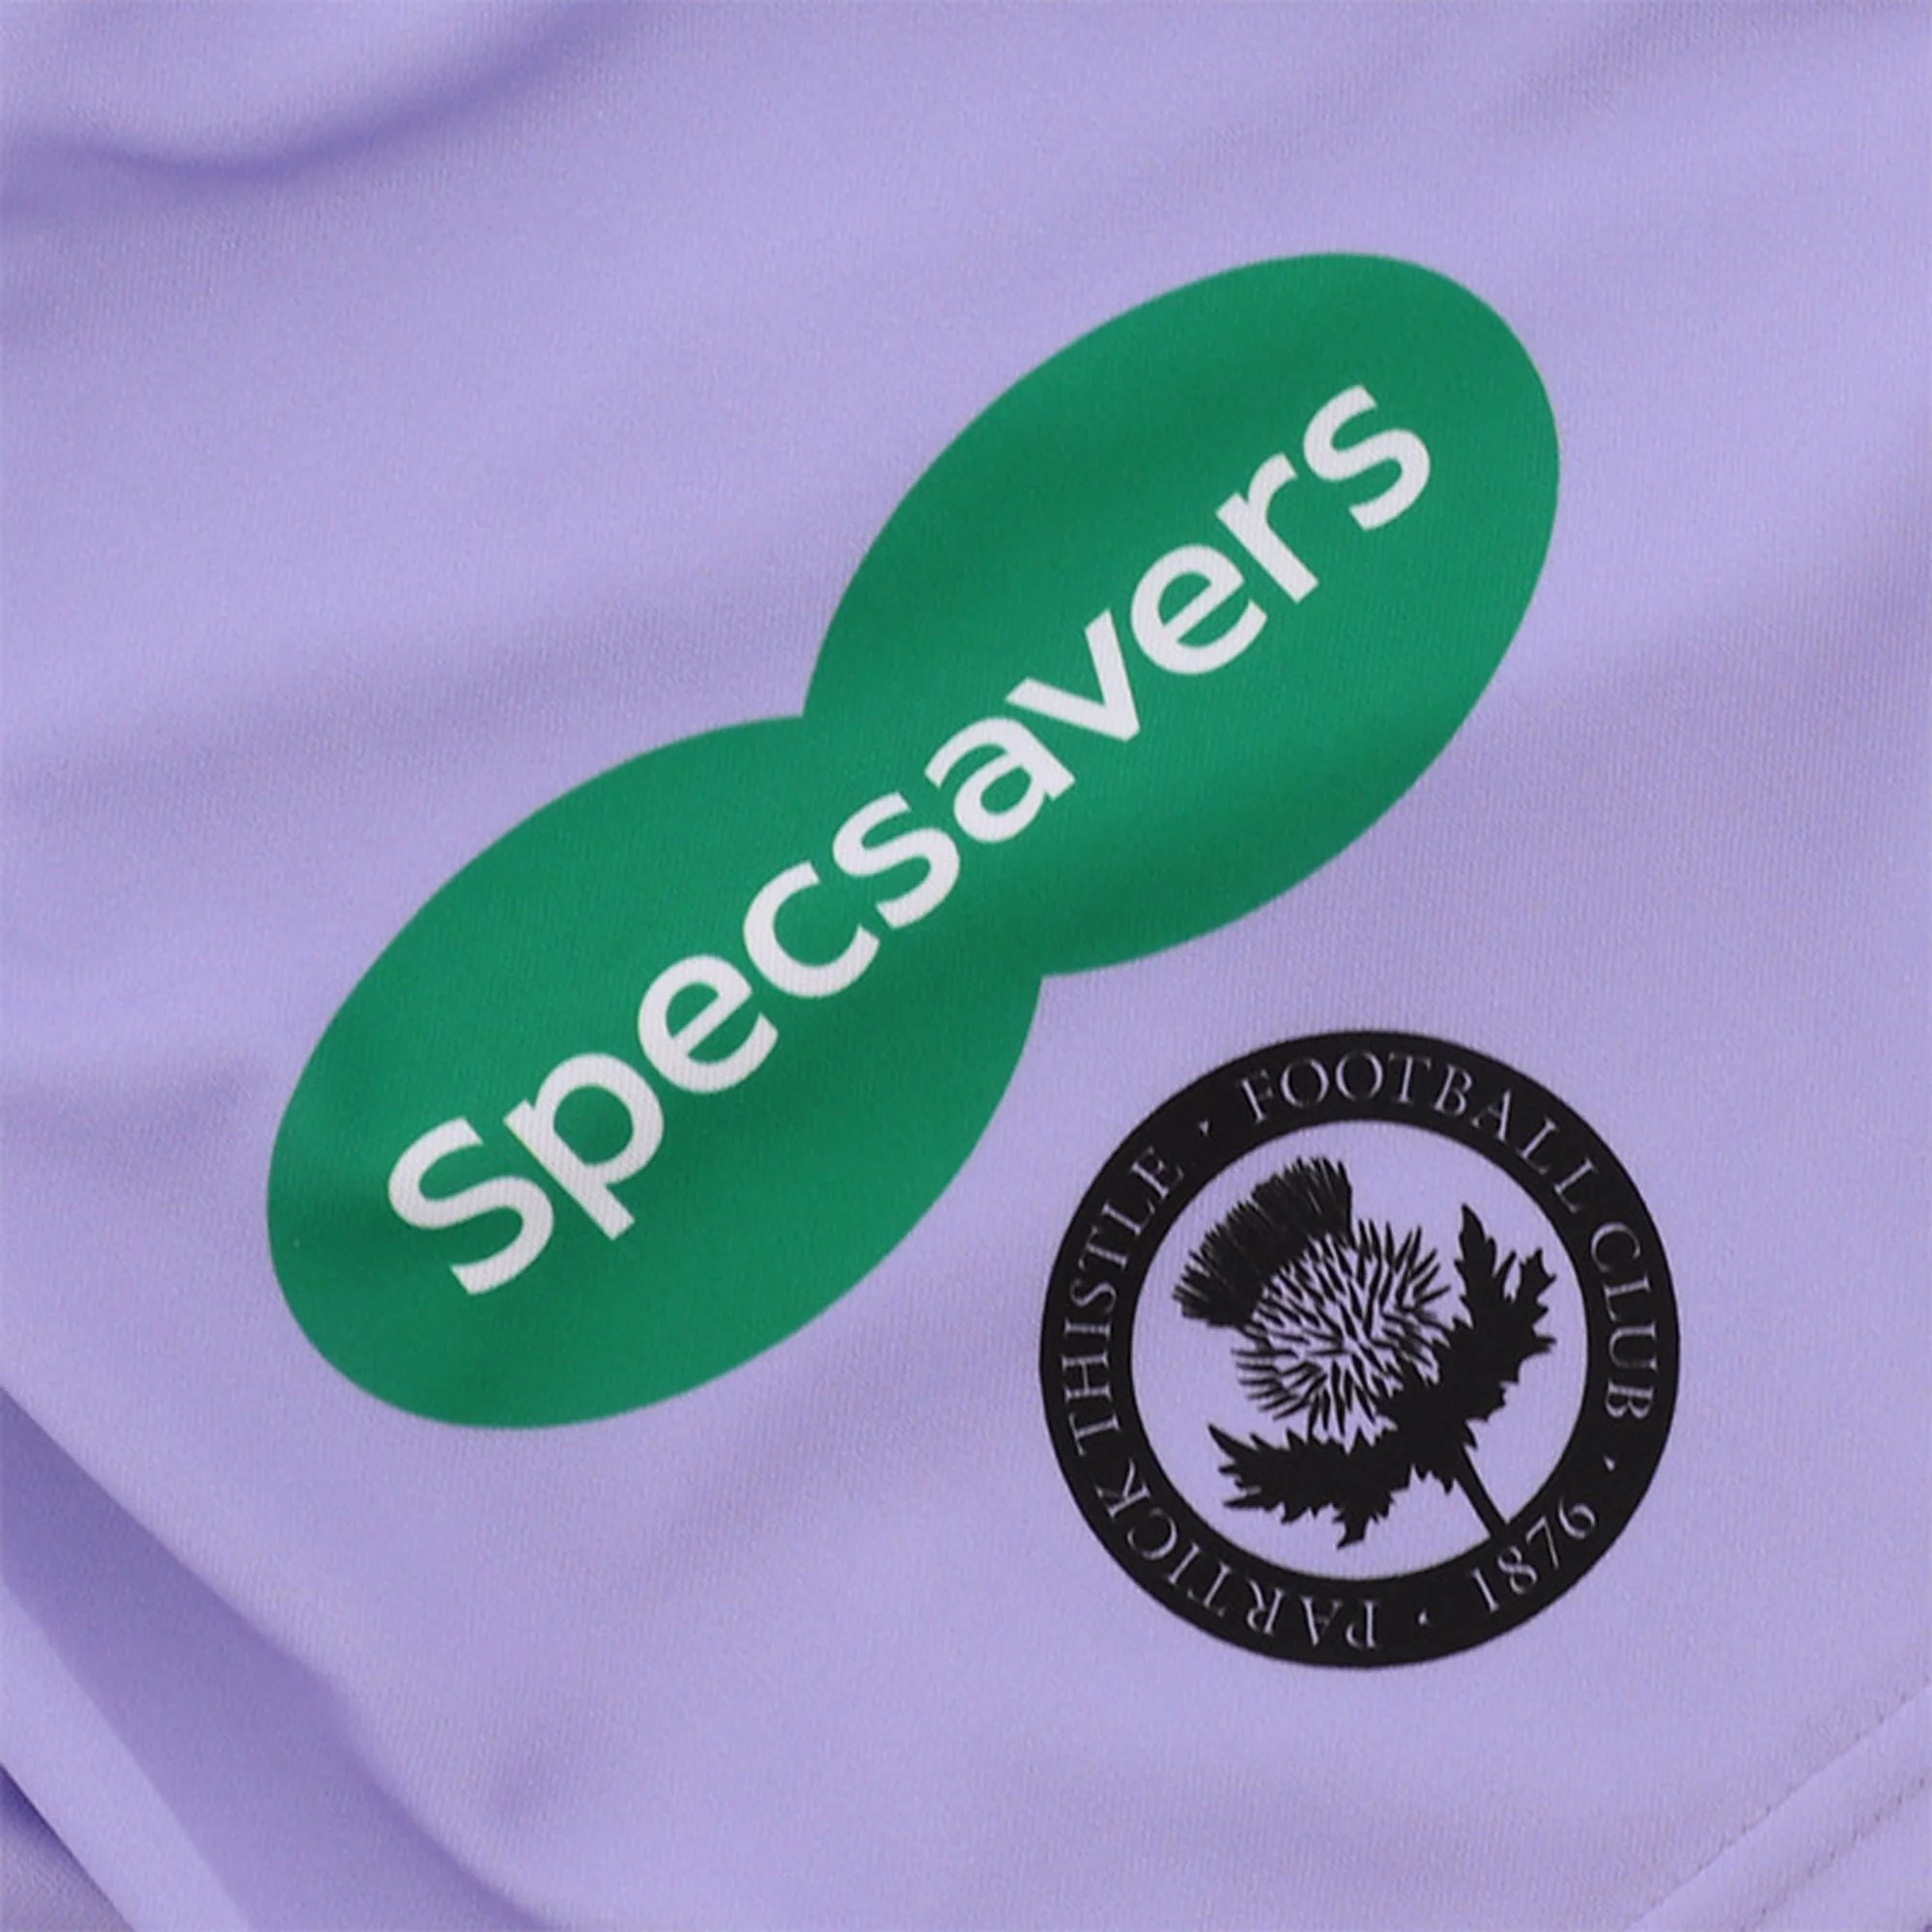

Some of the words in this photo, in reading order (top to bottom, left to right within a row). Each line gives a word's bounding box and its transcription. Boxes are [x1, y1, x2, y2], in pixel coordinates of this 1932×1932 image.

[387, 384, 1432, 1294] Specsavers
[1237, 1049, 1599, 1214] FOOTBALL
[1062, 1145, 1185, 1457] THISTLE
[1590, 1221, 1658, 1421] CLUB
[1095, 1461, 1383, 1649] PARTICK
[1468, 1496, 1597, 1613] 1876
